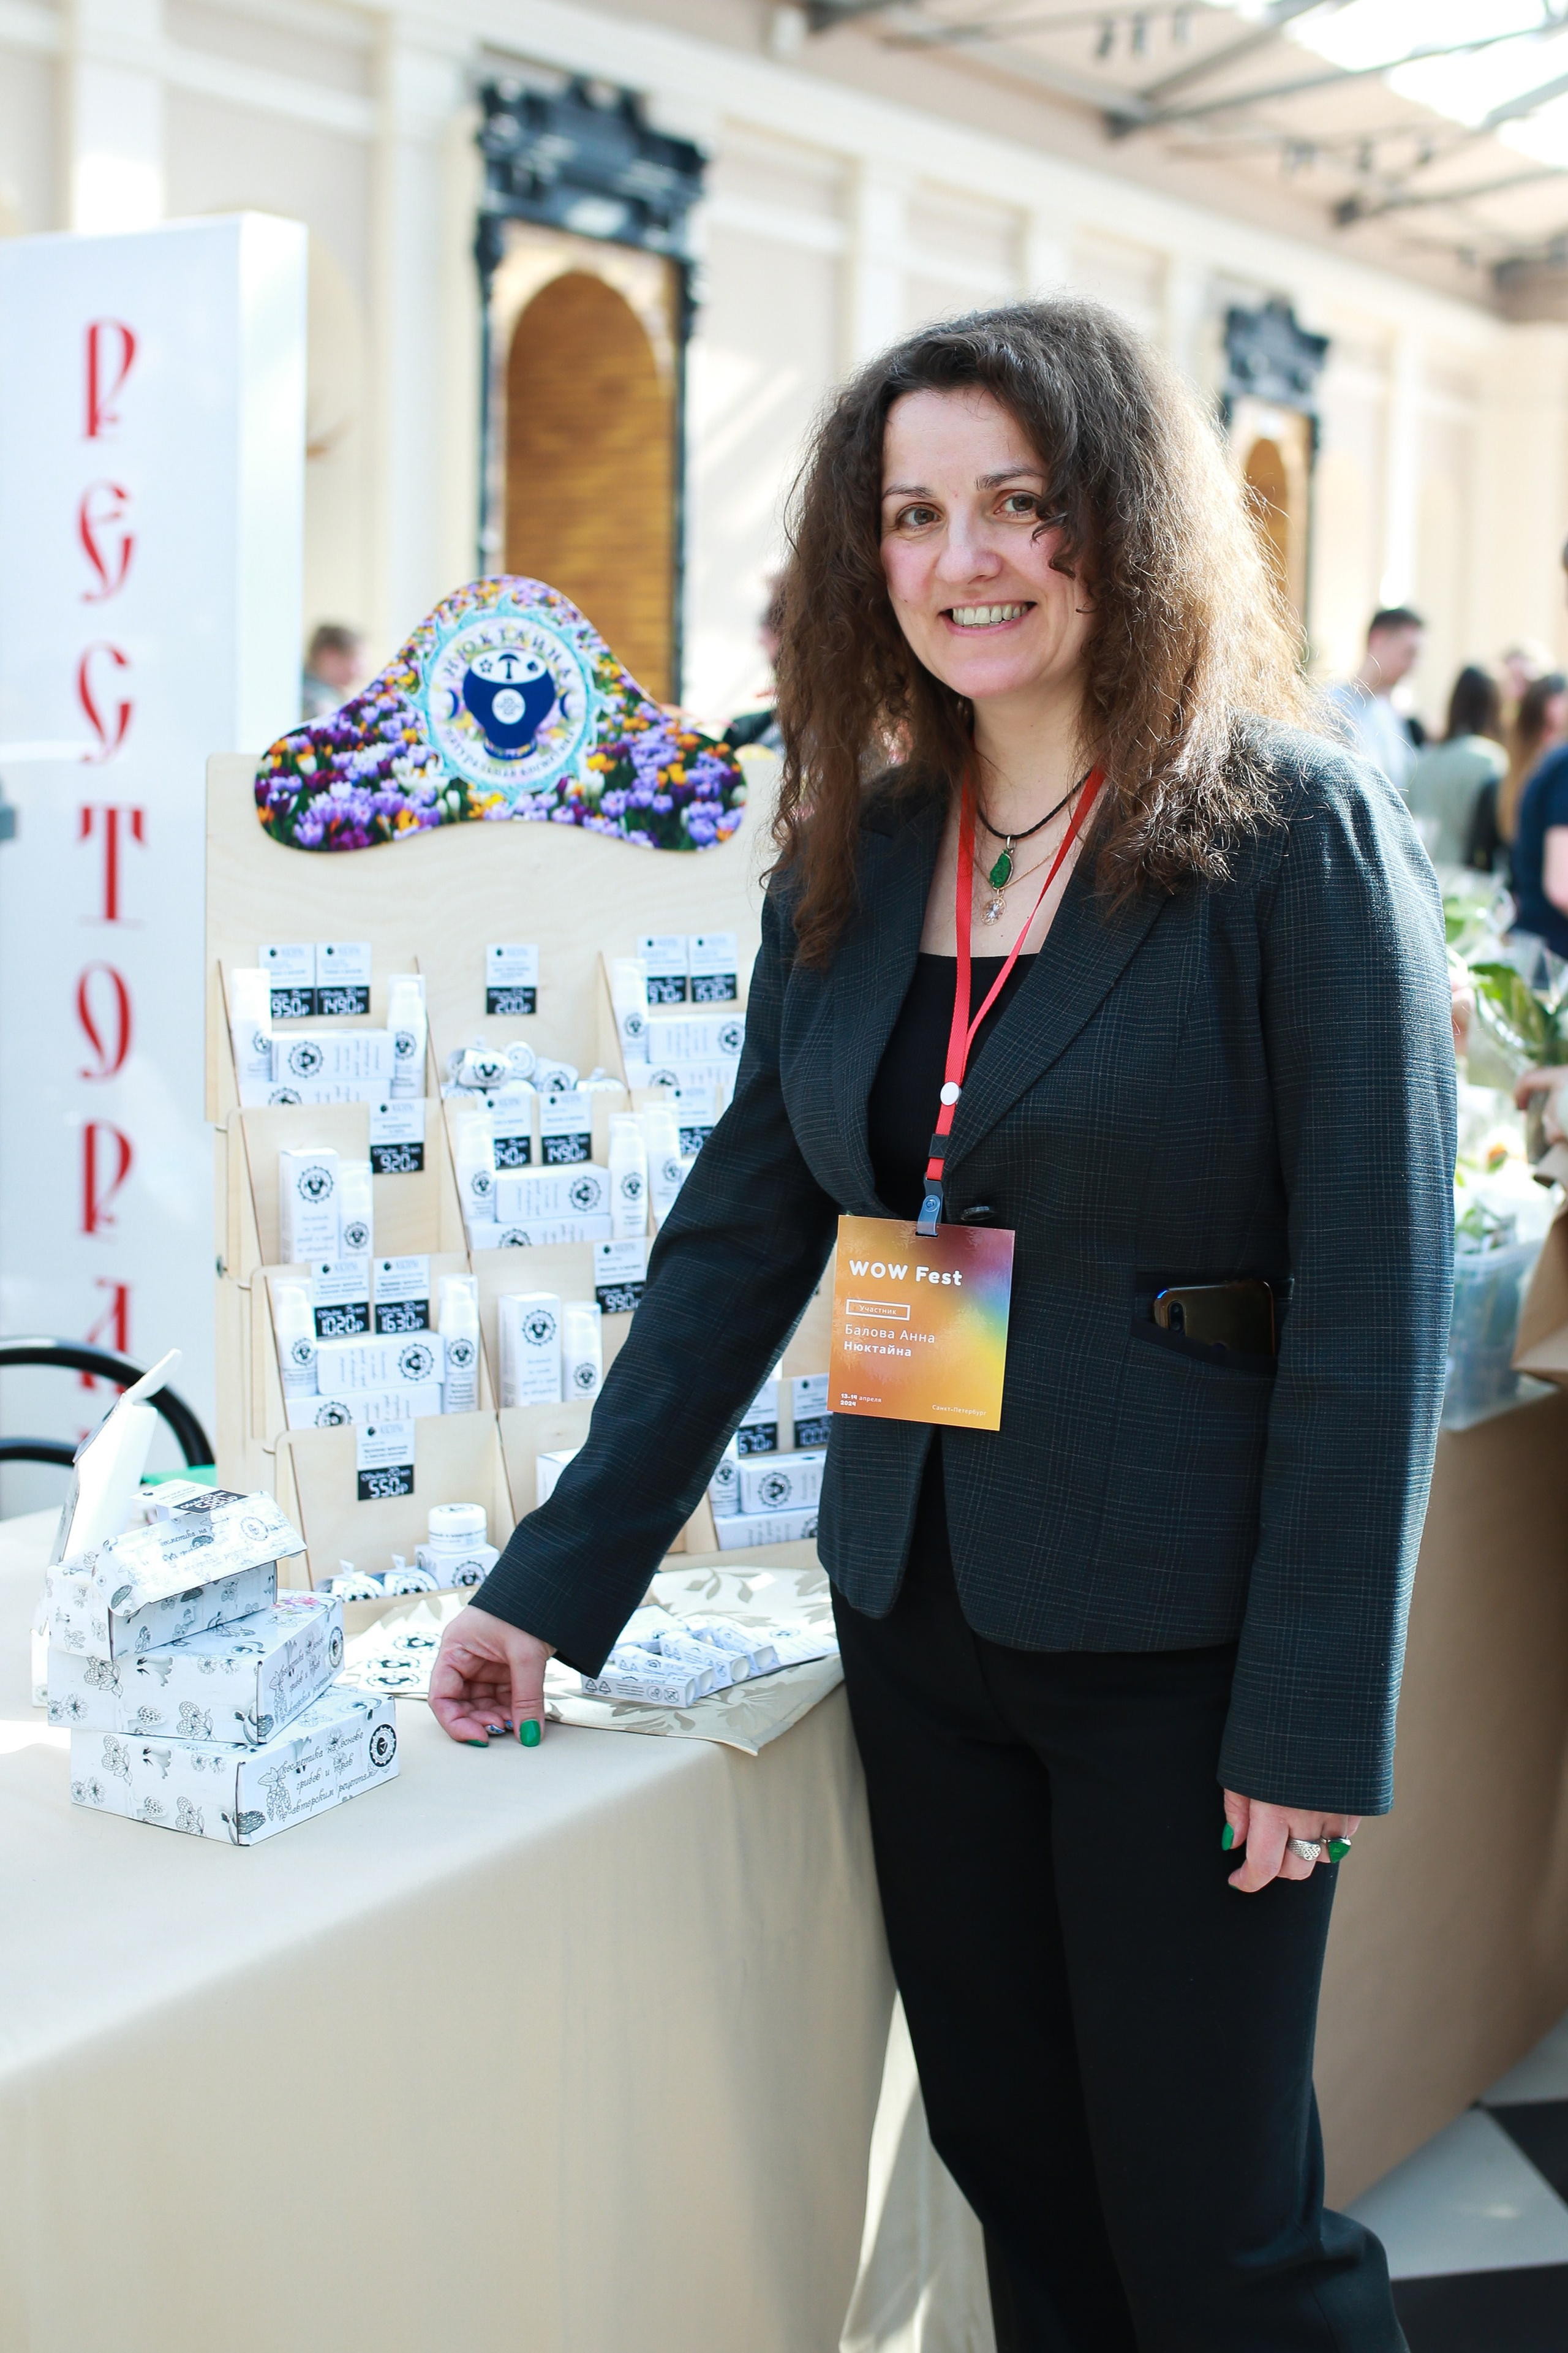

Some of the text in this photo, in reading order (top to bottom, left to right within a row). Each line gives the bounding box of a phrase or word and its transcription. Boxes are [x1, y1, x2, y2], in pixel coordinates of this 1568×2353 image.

[80, 315, 147, 1443] РЕСТОРА
[849, 1260, 963, 1286] WOW Fest
[859, 1305, 897, 1315] Участник
[845, 1324, 935, 1343] Балова Анна
[844, 1341, 912, 1357] Нюктайна
[932, 1403, 987, 1416] Санкт-Петербург
[282, 1746, 323, 1773] косметика
[341, 1728, 363, 1748] основе
[296, 1768, 322, 1795] грибов
[334, 1753, 353, 1776] трав
[292, 1788, 334, 1812] авторским
